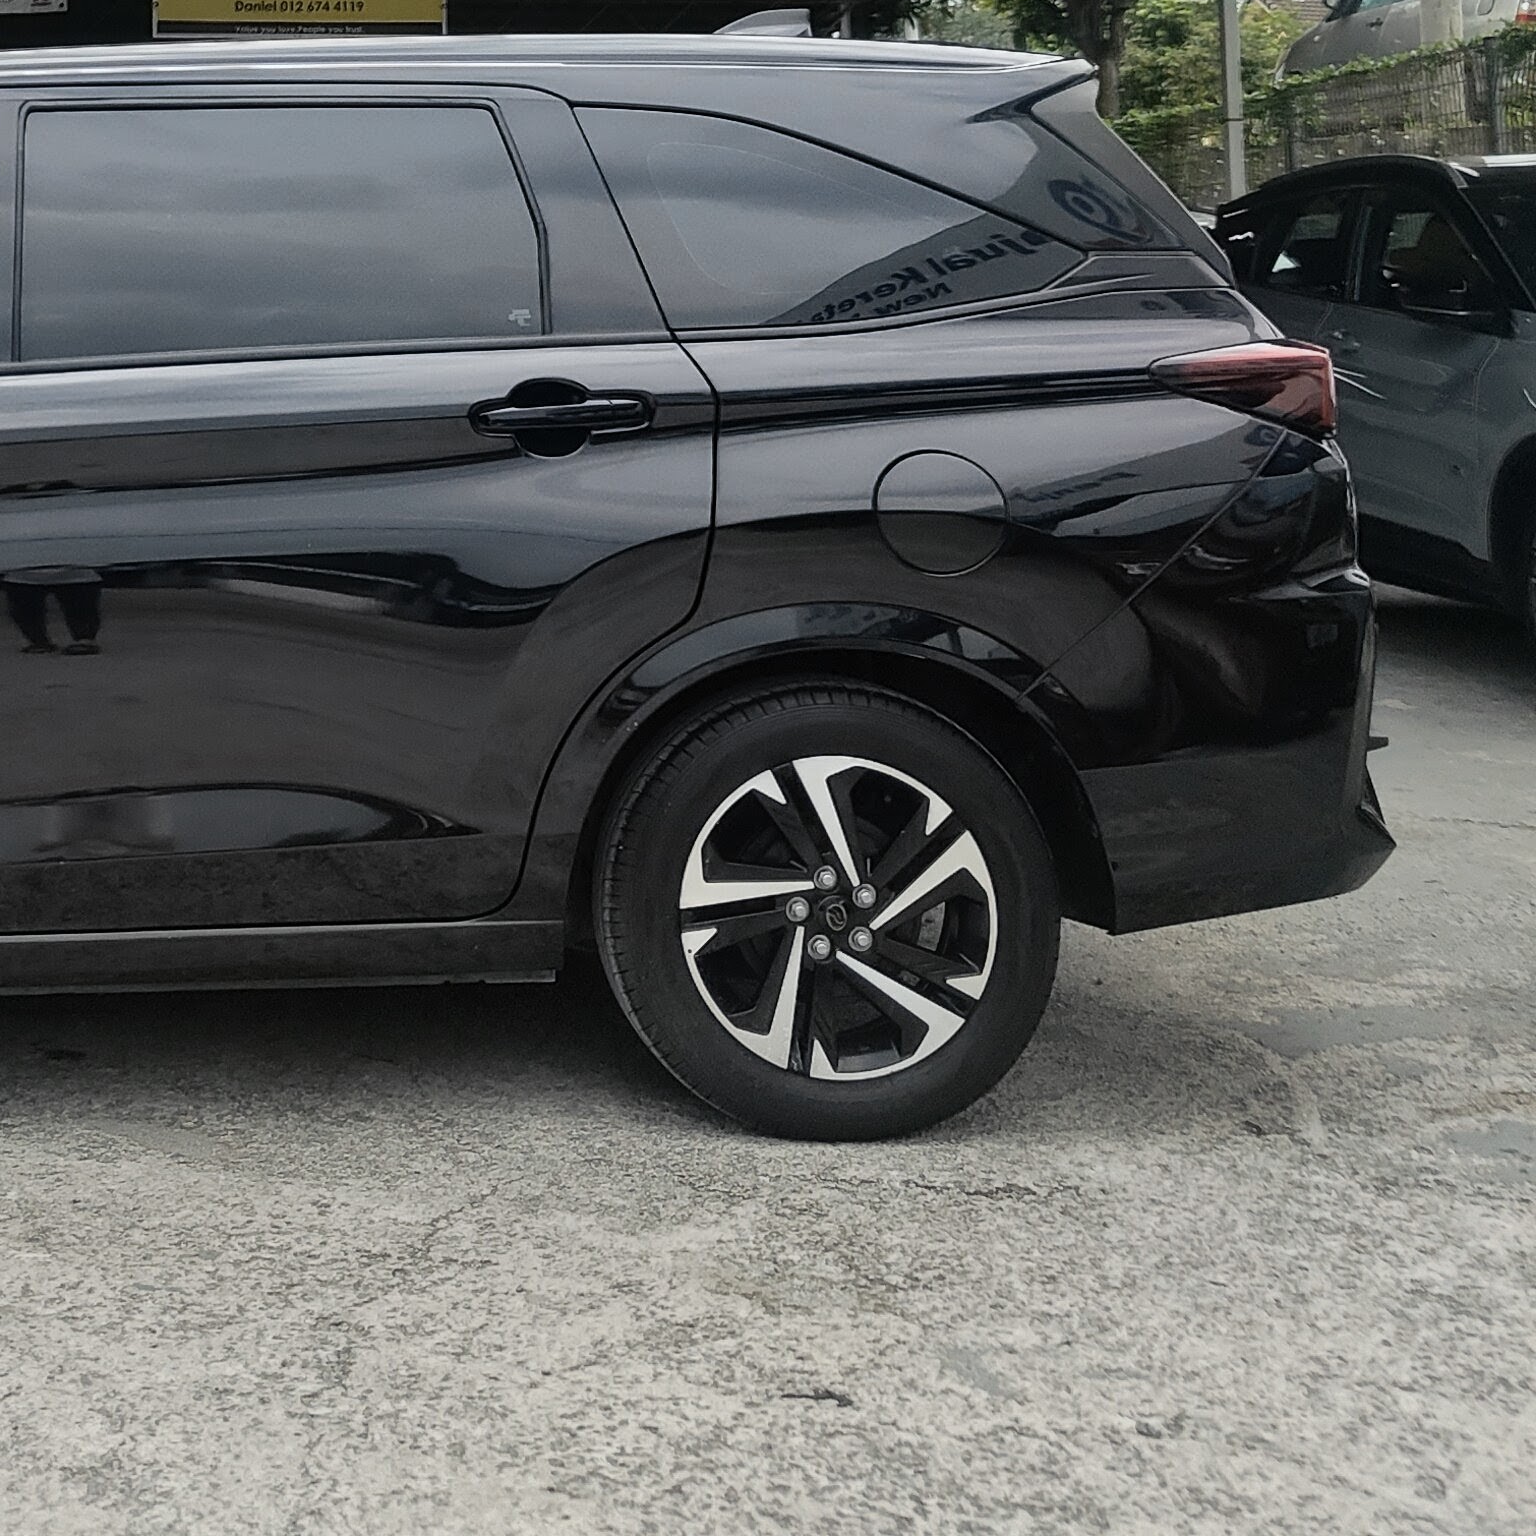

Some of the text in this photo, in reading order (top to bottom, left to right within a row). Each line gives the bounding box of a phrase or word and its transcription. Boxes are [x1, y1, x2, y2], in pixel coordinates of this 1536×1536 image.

[235, 1, 364, 12] Daniel 012 674 4119
